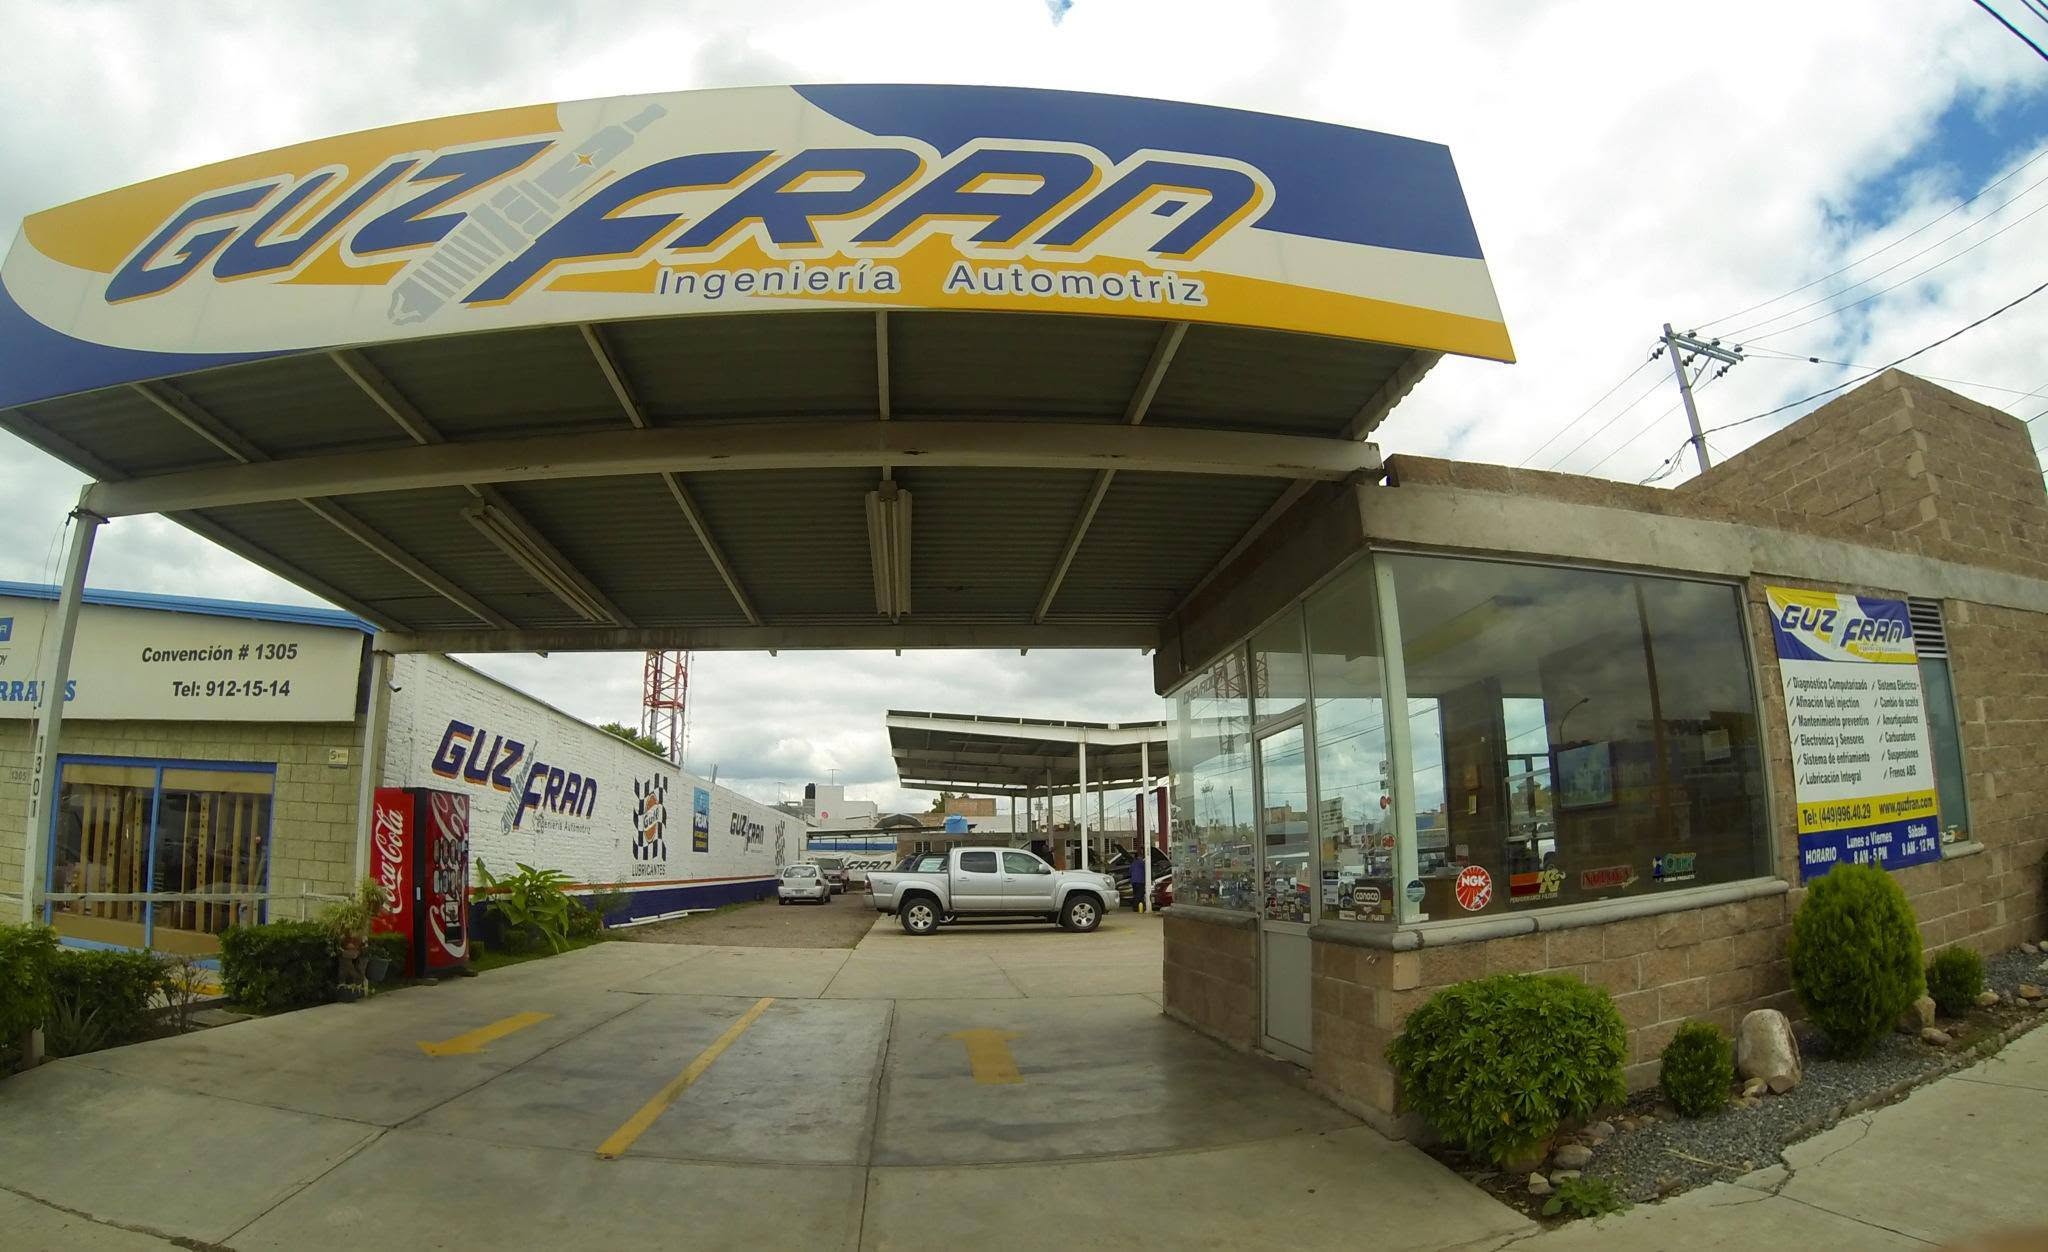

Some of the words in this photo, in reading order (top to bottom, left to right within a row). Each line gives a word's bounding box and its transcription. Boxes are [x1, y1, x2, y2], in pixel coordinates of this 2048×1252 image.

[105, 139, 557, 304] GUZ
[462, 147, 1262, 307] FRAN
[659, 264, 895, 299] Ingeniería
[948, 265, 1202, 301] Automotriz
[1781, 604, 1837, 632] GUZ
[1840, 618, 1903, 647] FRAN
[142, 645, 233, 662] Convención
[238, 644, 249, 661] #
[255, 643, 298, 660] 1305
[173, 681, 200, 697] Tel:
[205, 680, 290, 697] 912-15-14
[1793, 676, 1828, 692] Diagnóstico
[1796, 695, 1823, 708] Afinación
[1798, 714, 1841, 727] Mantenimiento
[1842, 715, 1870, 729] preventivo
[1800, 733, 1834, 747] Electrónica
[1840, 733, 1865, 745] Sensores
[1803, 753, 1828, 765] Sistema
[1828, 753, 1836, 764] de
[1837, 751, 1870, 764] enfriamiento
[1887, 748, 1919, 762] Suspensiones
[432, 719, 525, 792] GUZ
[512, 761, 597, 831] FRAN
[1805, 771, 1839, 785] Lubricación
[1840, 769, 1862, 785] Integral
[1889, 766, 1906, 778] Frenos
[1906, 764, 1917, 776] ABS
[1878, 793, 1933, 816] www.guzfran.com
[730, 812, 747, 836] GUZ
[1803, 809, 1818, 826] Tel:
[1819, 803, 1871, 828] (449)996.40.29
[1907, 823, 1928, 839] Sábado
[1846, 835, 1865, 849] Lunes
[1865, 836, 1870, 846] a
[1870, 831, 1893, 846] Viernes
[1902, 843, 1906, 856] 8
[1906, 841, 1916, 854] AM
[1919, 839, 1926, 852] 12
[1926, 838, 1935, 851] PM
[1805, 846, 1837, 864] HORARIO
[1853, 851, 1858, 864] 8
[1858, 850, 1869, 863] AM
[1873, 848, 1878, 861] 5
[1878, 846, 1888, 860] PM
[632, 864, 666, 877] LUBRICANTES
[1461, 874, 1486, 887] NGK
